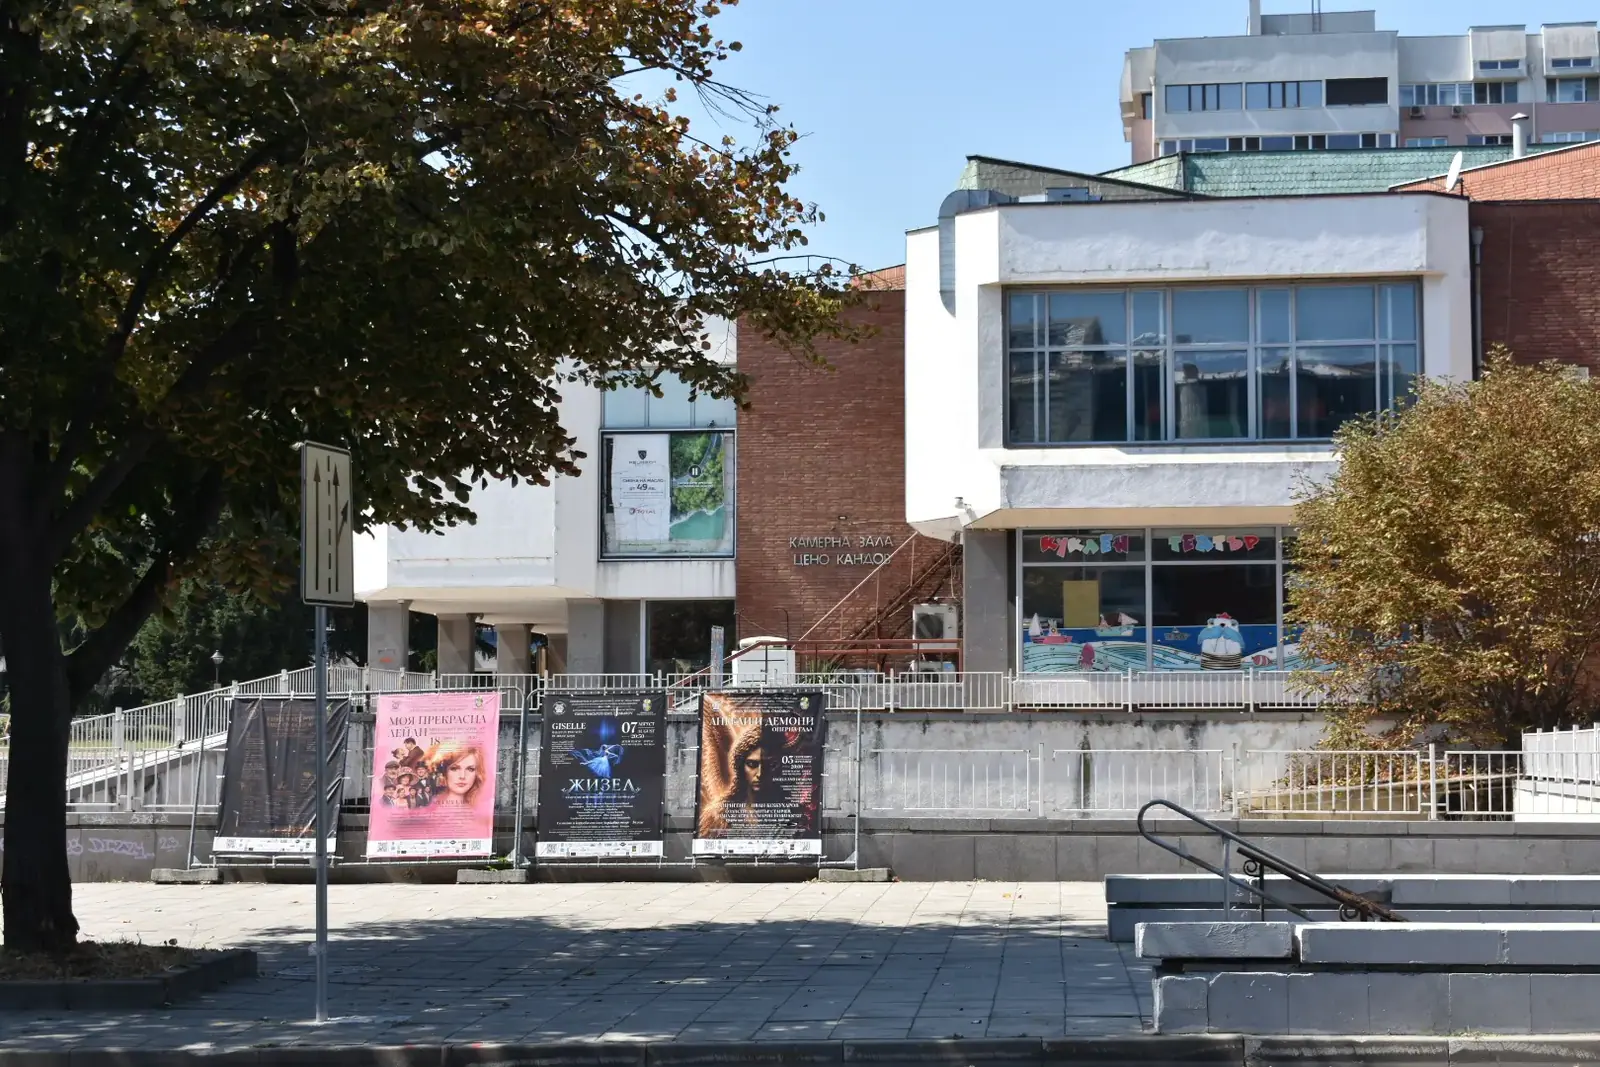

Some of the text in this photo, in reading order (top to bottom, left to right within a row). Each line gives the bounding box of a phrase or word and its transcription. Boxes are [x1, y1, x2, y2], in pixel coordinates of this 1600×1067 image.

[636, 483, 648, 491] 49
[789, 535, 894, 548] КАМЕРНА ЗАЛА
[1039, 533, 1260, 558] КУКЛЕН ТЕАТЪР
[793, 552, 891, 567] ЦЕНО КАНДОВ
[389, 714, 487, 726] МОЯ ПРЕКРАСНА
[551, 722, 587, 730] GISELLE
[764, 716, 814, 727] ДЕМОНИ
[621, 721, 638, 734] 07
[568, 778, 635, 793] ЖИЗЕЛ
